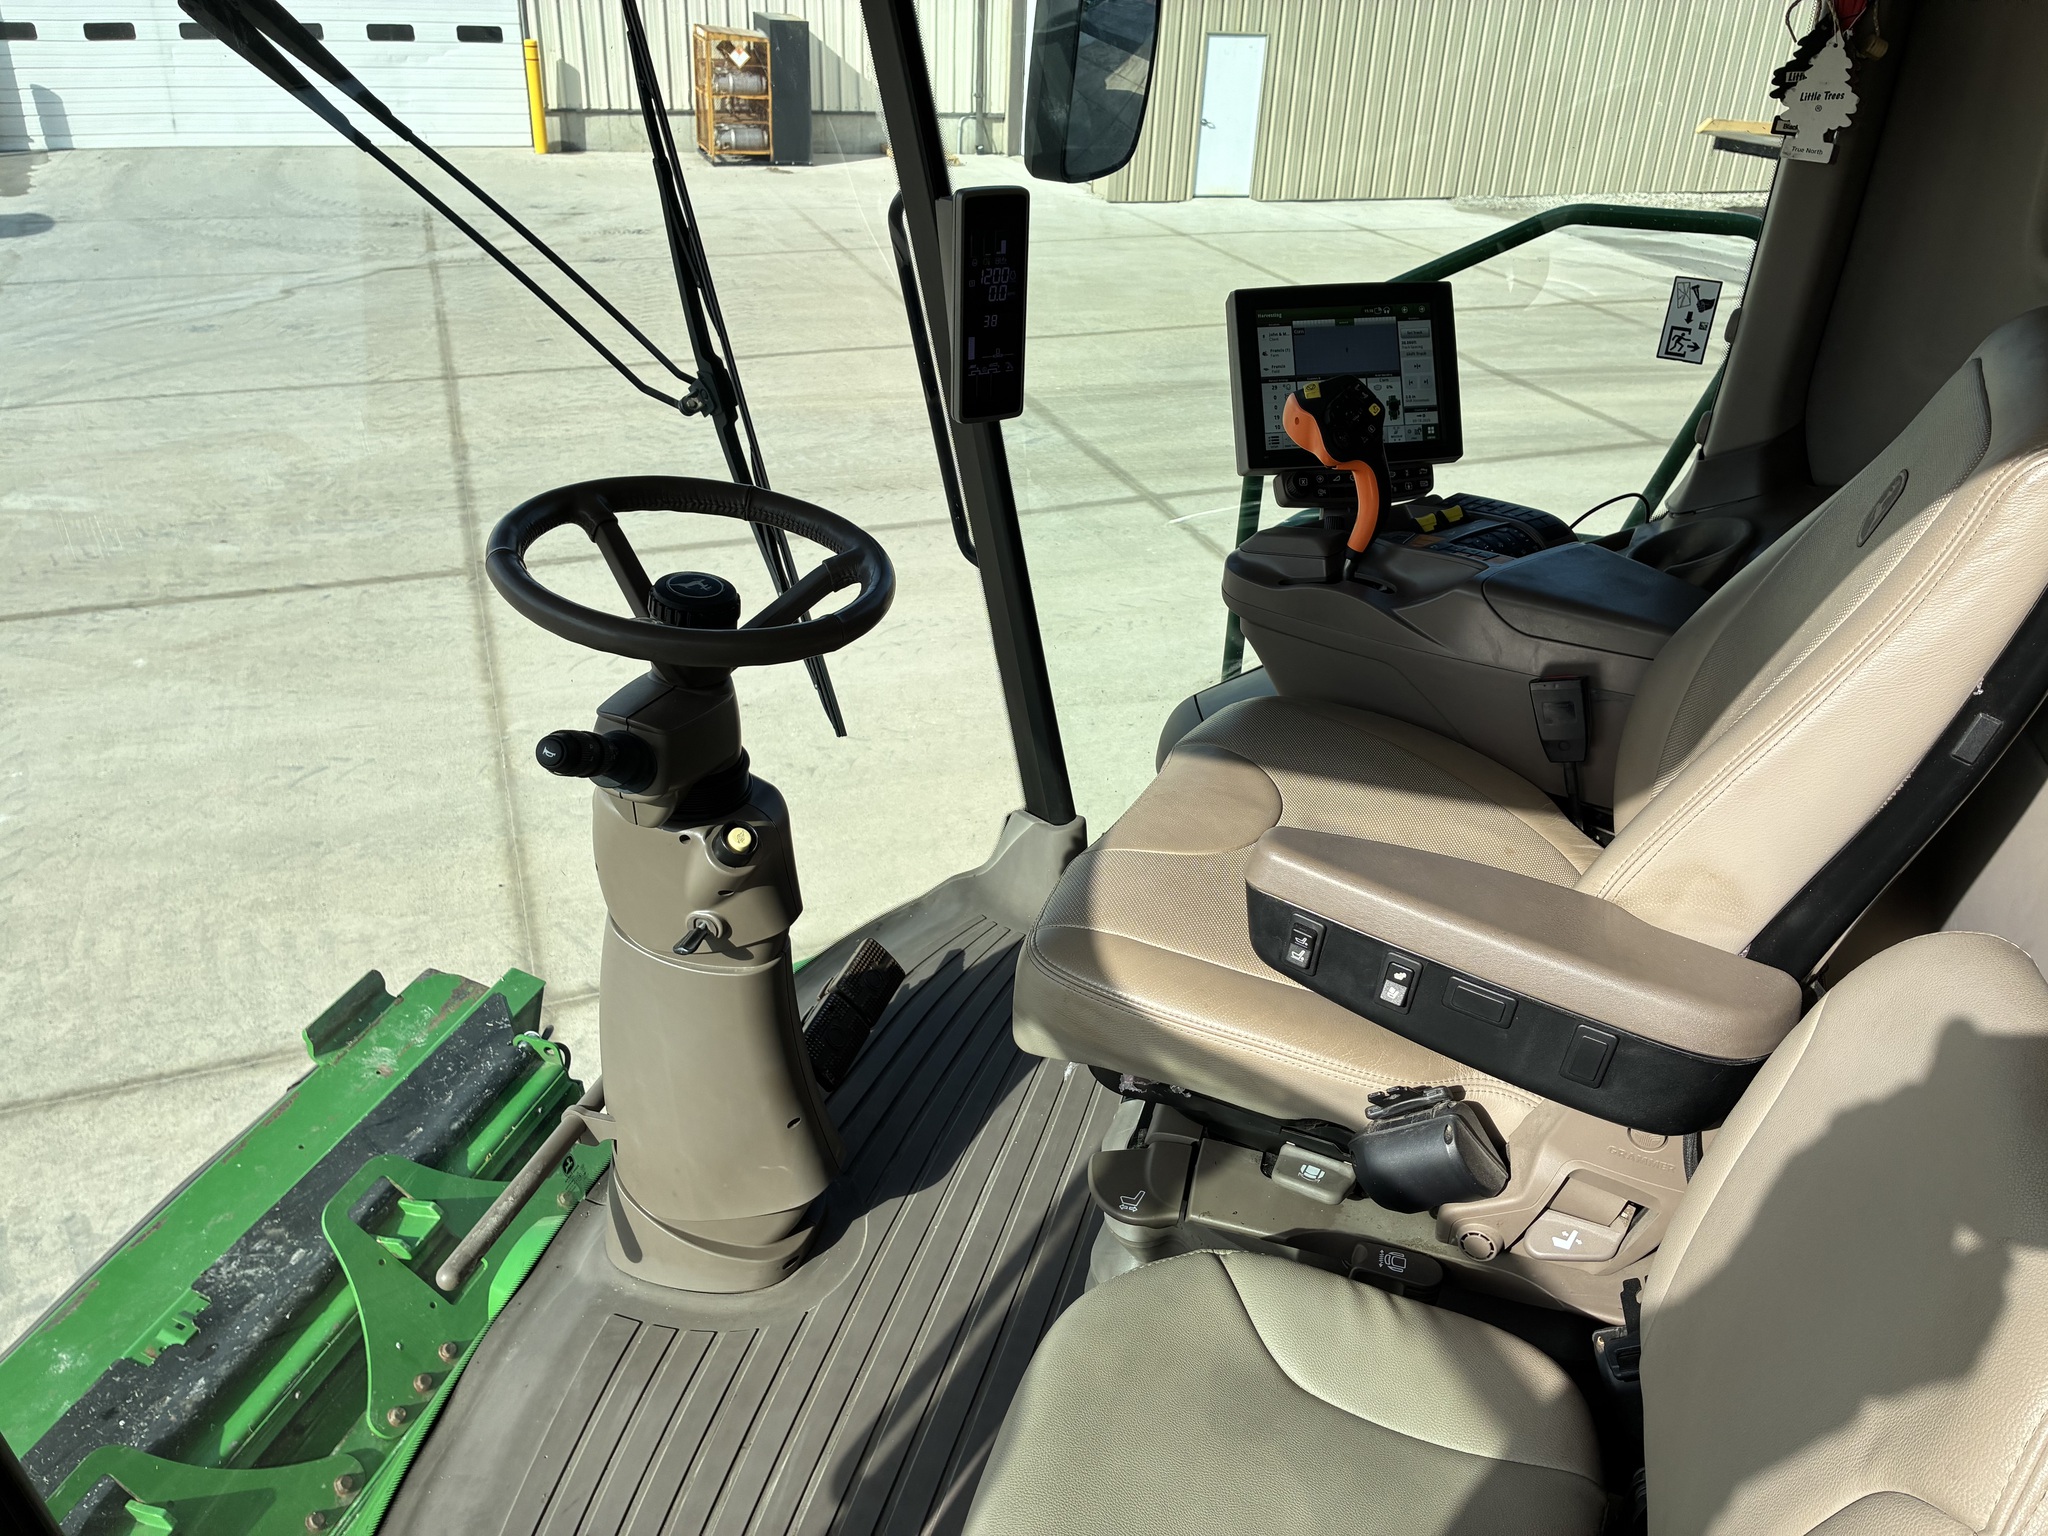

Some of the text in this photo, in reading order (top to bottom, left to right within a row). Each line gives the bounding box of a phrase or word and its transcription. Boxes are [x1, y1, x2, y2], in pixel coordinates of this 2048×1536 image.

[1800, 91, 1845, 101] Little Trees
[1806, 147, 1823, 155] North
[981, 267, 1010, 285] 1200
[988, 285, 1007, 302] 0.0
[983, 314, 998, 328] 38
[1606, 1145, 1677, 1173] GRAMMER
